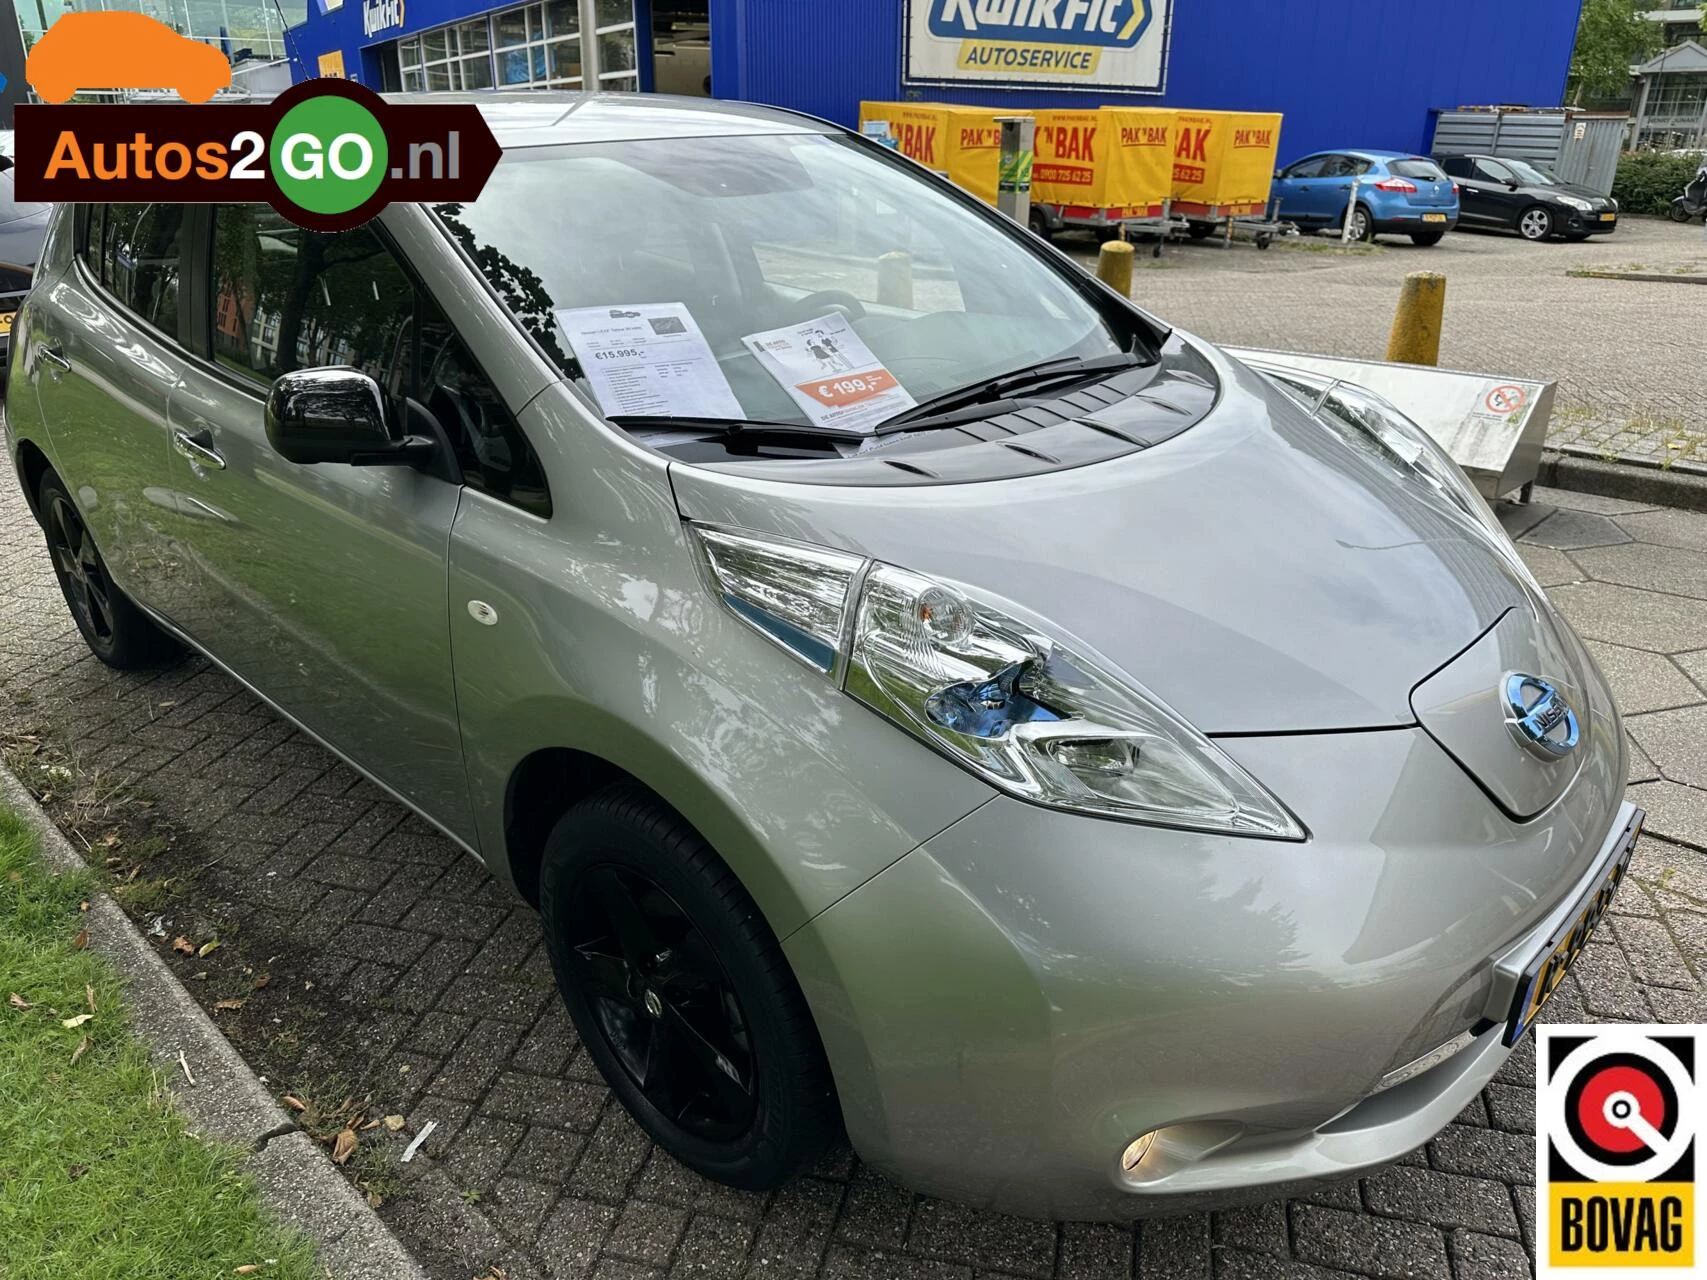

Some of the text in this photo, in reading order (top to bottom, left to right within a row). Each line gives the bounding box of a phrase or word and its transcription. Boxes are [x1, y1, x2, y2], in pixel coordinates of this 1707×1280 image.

[966, 47, 1092, 69] AUTOSERVICE
[960, 128, 984, 146] PAK
[1121, 127, 1140, 142] PAK
[1147, 127, 1168, 143] BAK
[1233, 130, 1250, 146] PAK
[1255, 129, 1272, 146] BAK
[904, 124, 936, 164] BAK
[1055, 126, 1096, 162] BAK
[1176, 128, 1212, 162] AK
[1059, 169, 1072, 182] 725
[1072, 170, 1082, 183] 62
[1082, 171, 1092, 183] 25
[595, 348, 645, 361] €15.995,-
[818, 385, 833, 398] €
